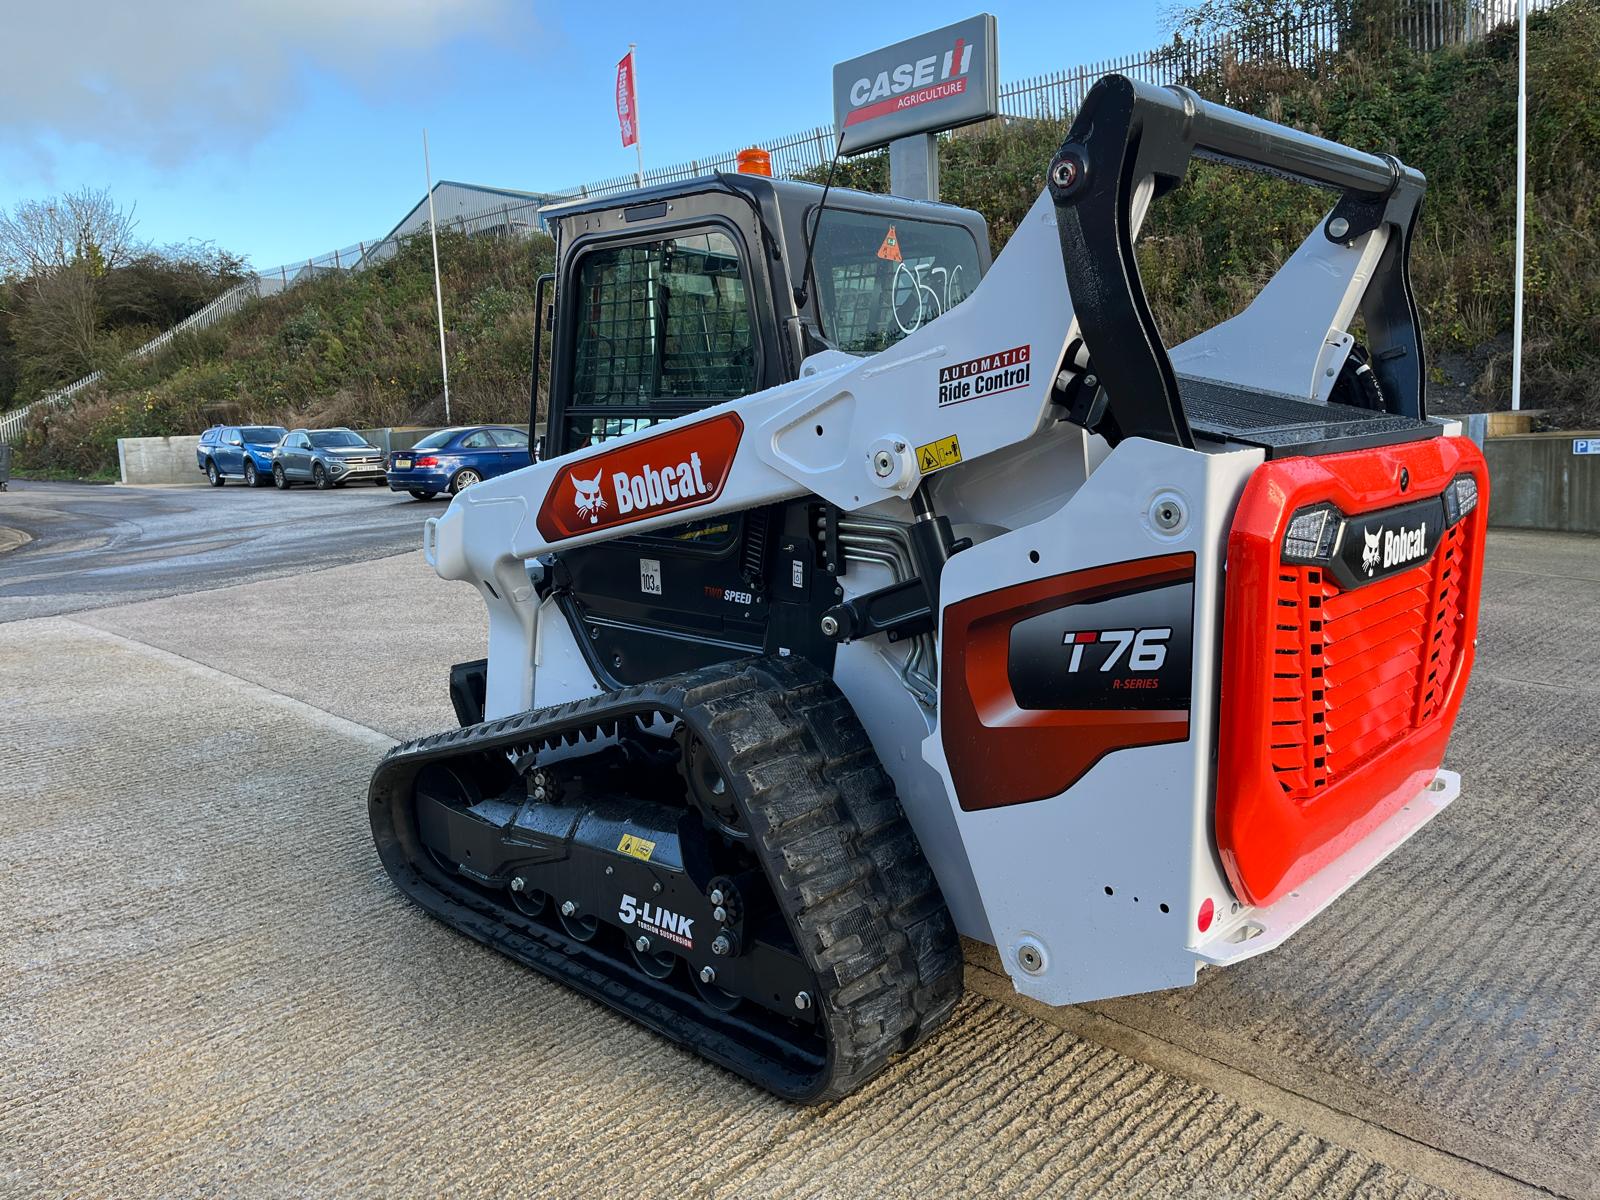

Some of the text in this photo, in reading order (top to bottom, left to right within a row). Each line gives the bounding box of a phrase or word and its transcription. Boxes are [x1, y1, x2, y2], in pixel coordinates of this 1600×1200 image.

[618, 66, 629, 115] Bobcat
[850, 55, 937, 106] CASE
[897, 80, 962, 109] AGRICULTURE
[939, 363, 1030, 404] Ride Control
[942, 348, 1027, 382] AUTOMATIC
[1383, 521, 1426, 568] Bobcat
[641, 573, 655, 591] 103
[724, 589, 752, 605] SPEED
[1063, 628, 1171, 672] T76
[1112, 678, 1159, 689] R-SERIES
[618, 893, 695, 940] 5-LINK
[637, 920, 692, 949] TORSION SUSPENSION
